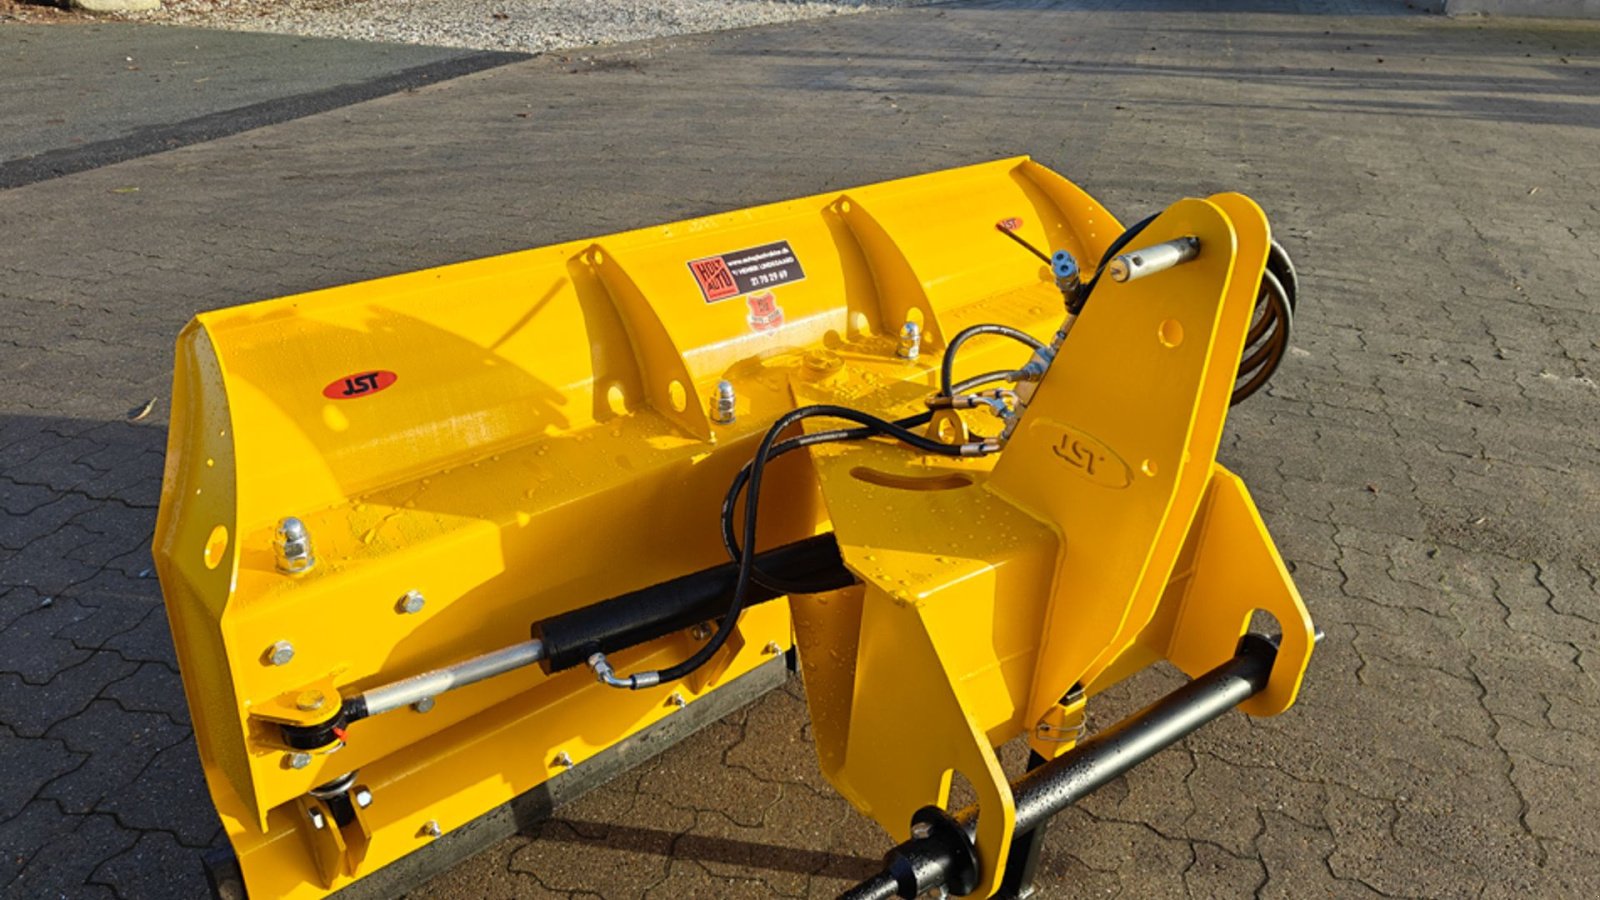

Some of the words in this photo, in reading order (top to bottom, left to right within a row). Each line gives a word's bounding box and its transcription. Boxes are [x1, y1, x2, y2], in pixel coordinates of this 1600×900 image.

[697, 259, 721, 282] HOLT
[707, 268, 732, 291] AUTO
[342, 372, 379, 396] JST
[1052, 432, 1095, 476] JST
